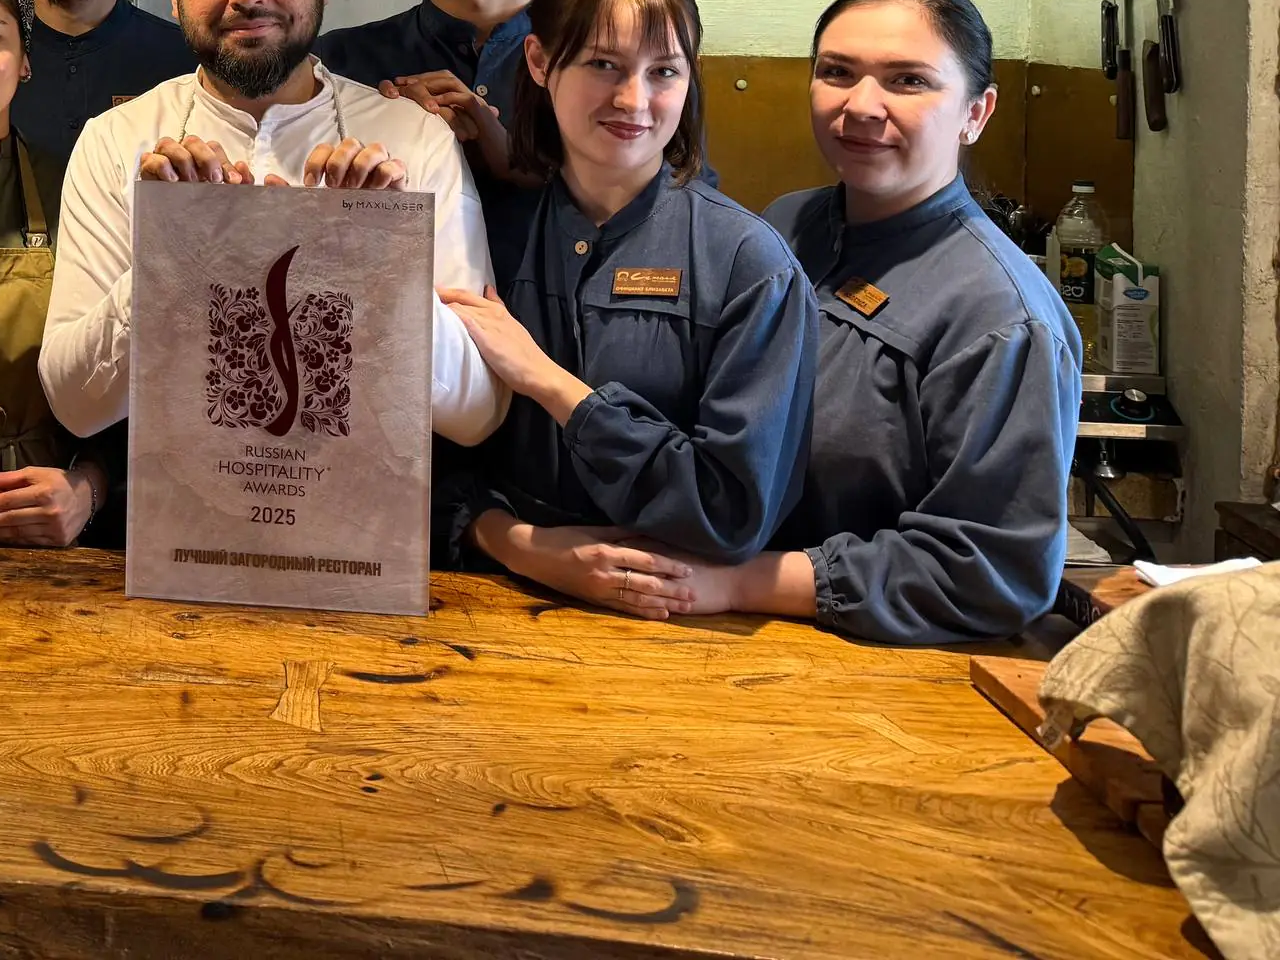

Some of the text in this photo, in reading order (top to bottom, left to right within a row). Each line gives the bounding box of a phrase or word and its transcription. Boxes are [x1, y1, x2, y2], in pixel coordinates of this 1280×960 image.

[342, 199, 424, 212] by MAXILASER
[245, 445, 306, 462] RUSSIAN
[218, 460, 325, 481] HOSPITALITY
[243, 481, 306, 497] AWARDS
[250, 506, 296, 526] 2025
[173, 548, 382, 577] ЛУЧШИЙ ЗАГОРОДНЫЙ РЕСТОРАН
